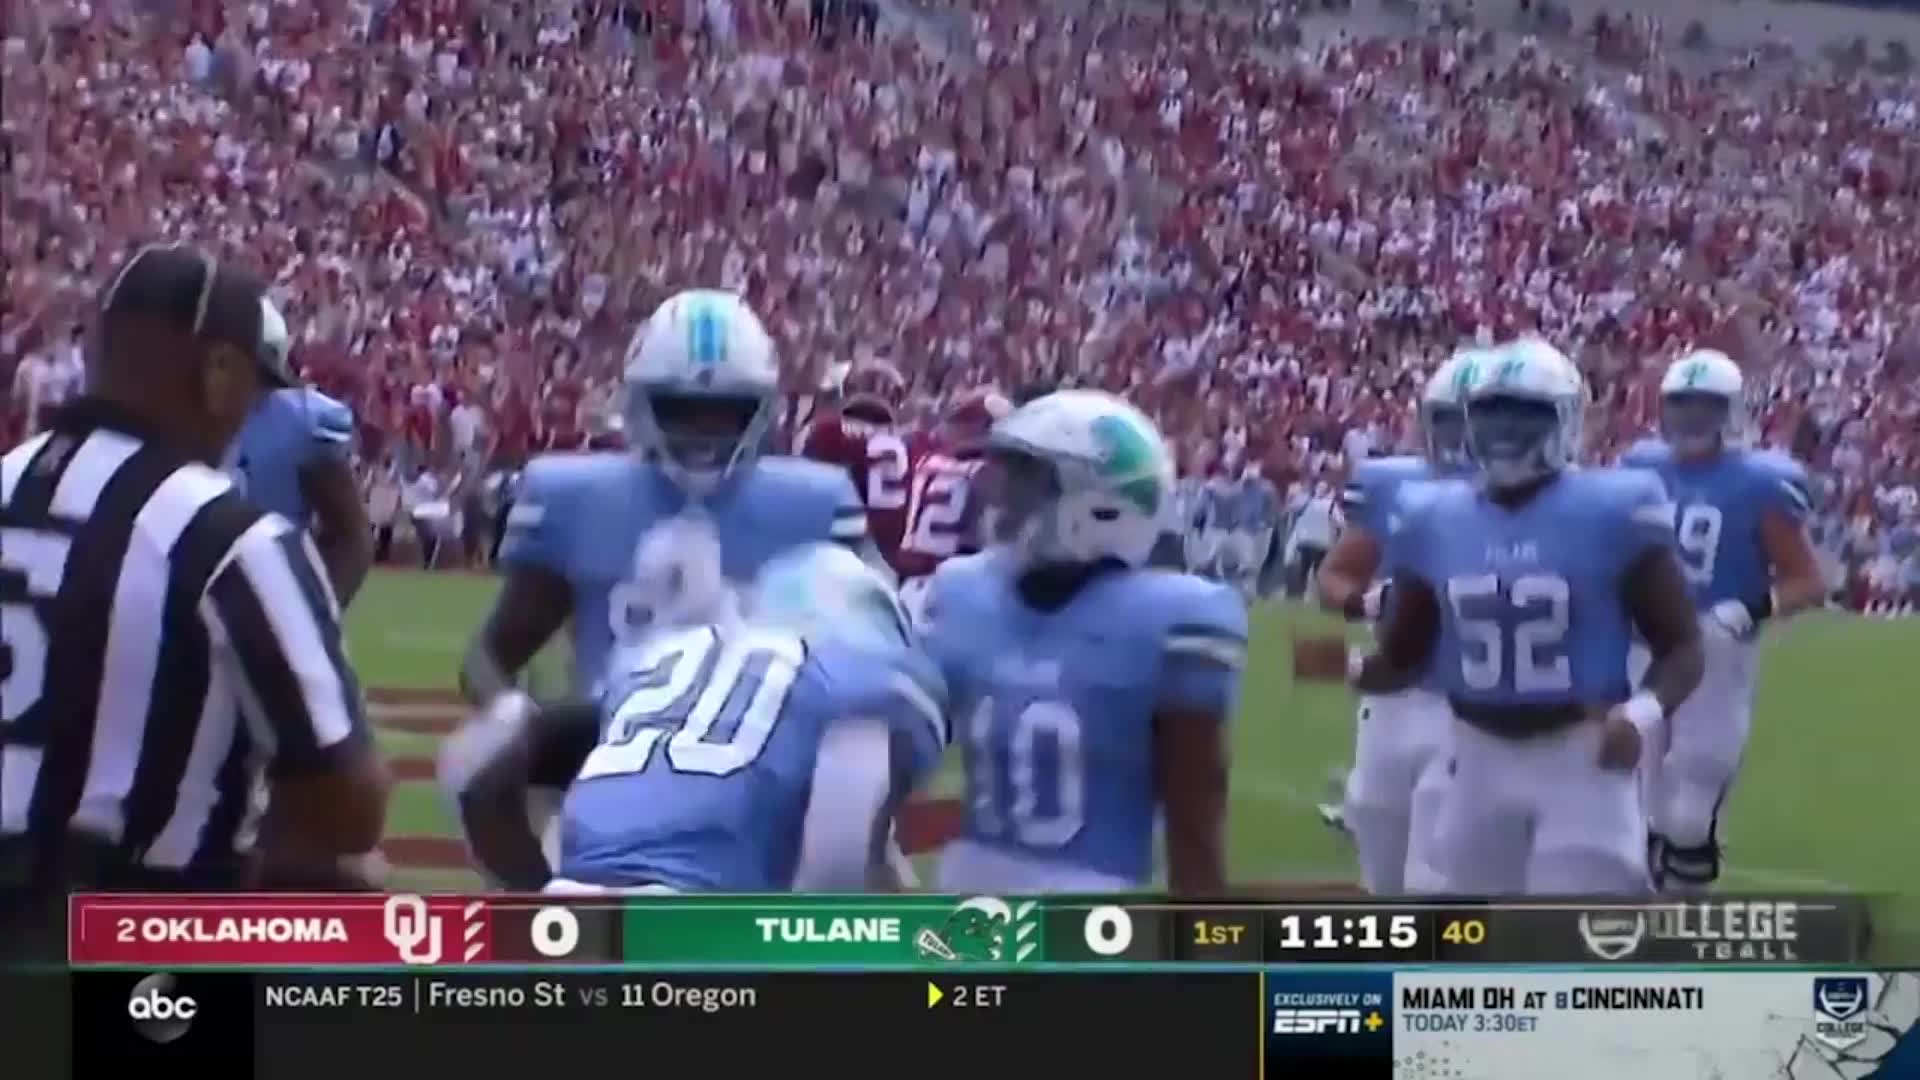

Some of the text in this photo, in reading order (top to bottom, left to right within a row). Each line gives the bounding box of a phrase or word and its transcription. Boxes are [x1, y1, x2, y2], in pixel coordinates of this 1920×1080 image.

[577, 624, 809, 780] 20
[1447, 573, 1572, 693] 52
[968, 695, 1087, 845] 10
